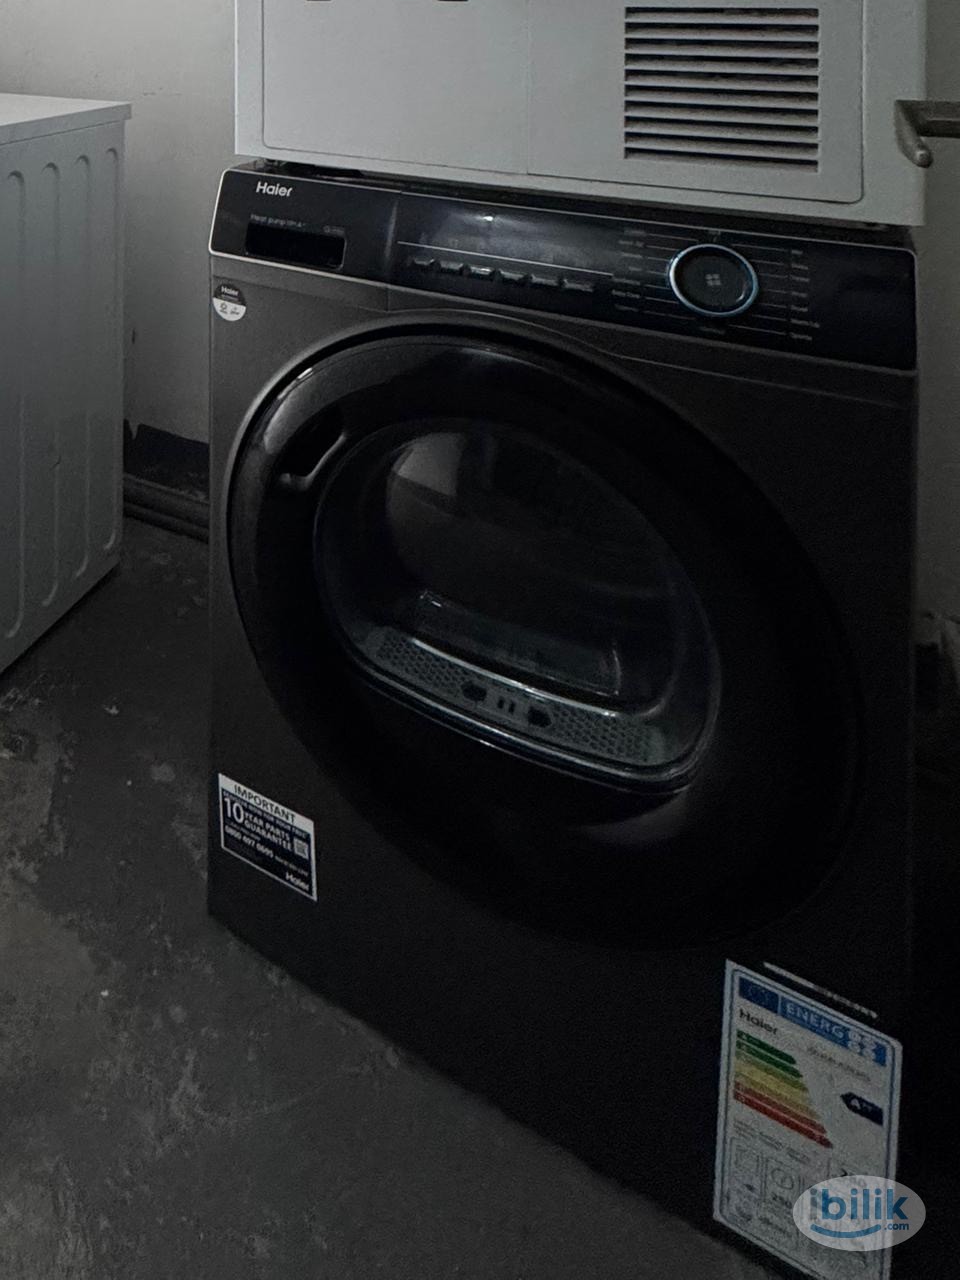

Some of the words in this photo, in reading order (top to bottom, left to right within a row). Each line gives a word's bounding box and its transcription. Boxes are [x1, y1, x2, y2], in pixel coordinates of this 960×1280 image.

[255, 181, 293, 197] Haier
[221, 285, 239, 297] Haier
[224, 797, 245, 824] 10
[234, 784, 295, 823] IMPORTANT
[244, 819, 292, 851] GUARANTEE
[245, 811, 264, 829] YEAR
[265, 822, 290, 841] PARTS
[740, 1007, 778, 1036] Haier
[786, 1002, 844, 1039] ENERG
